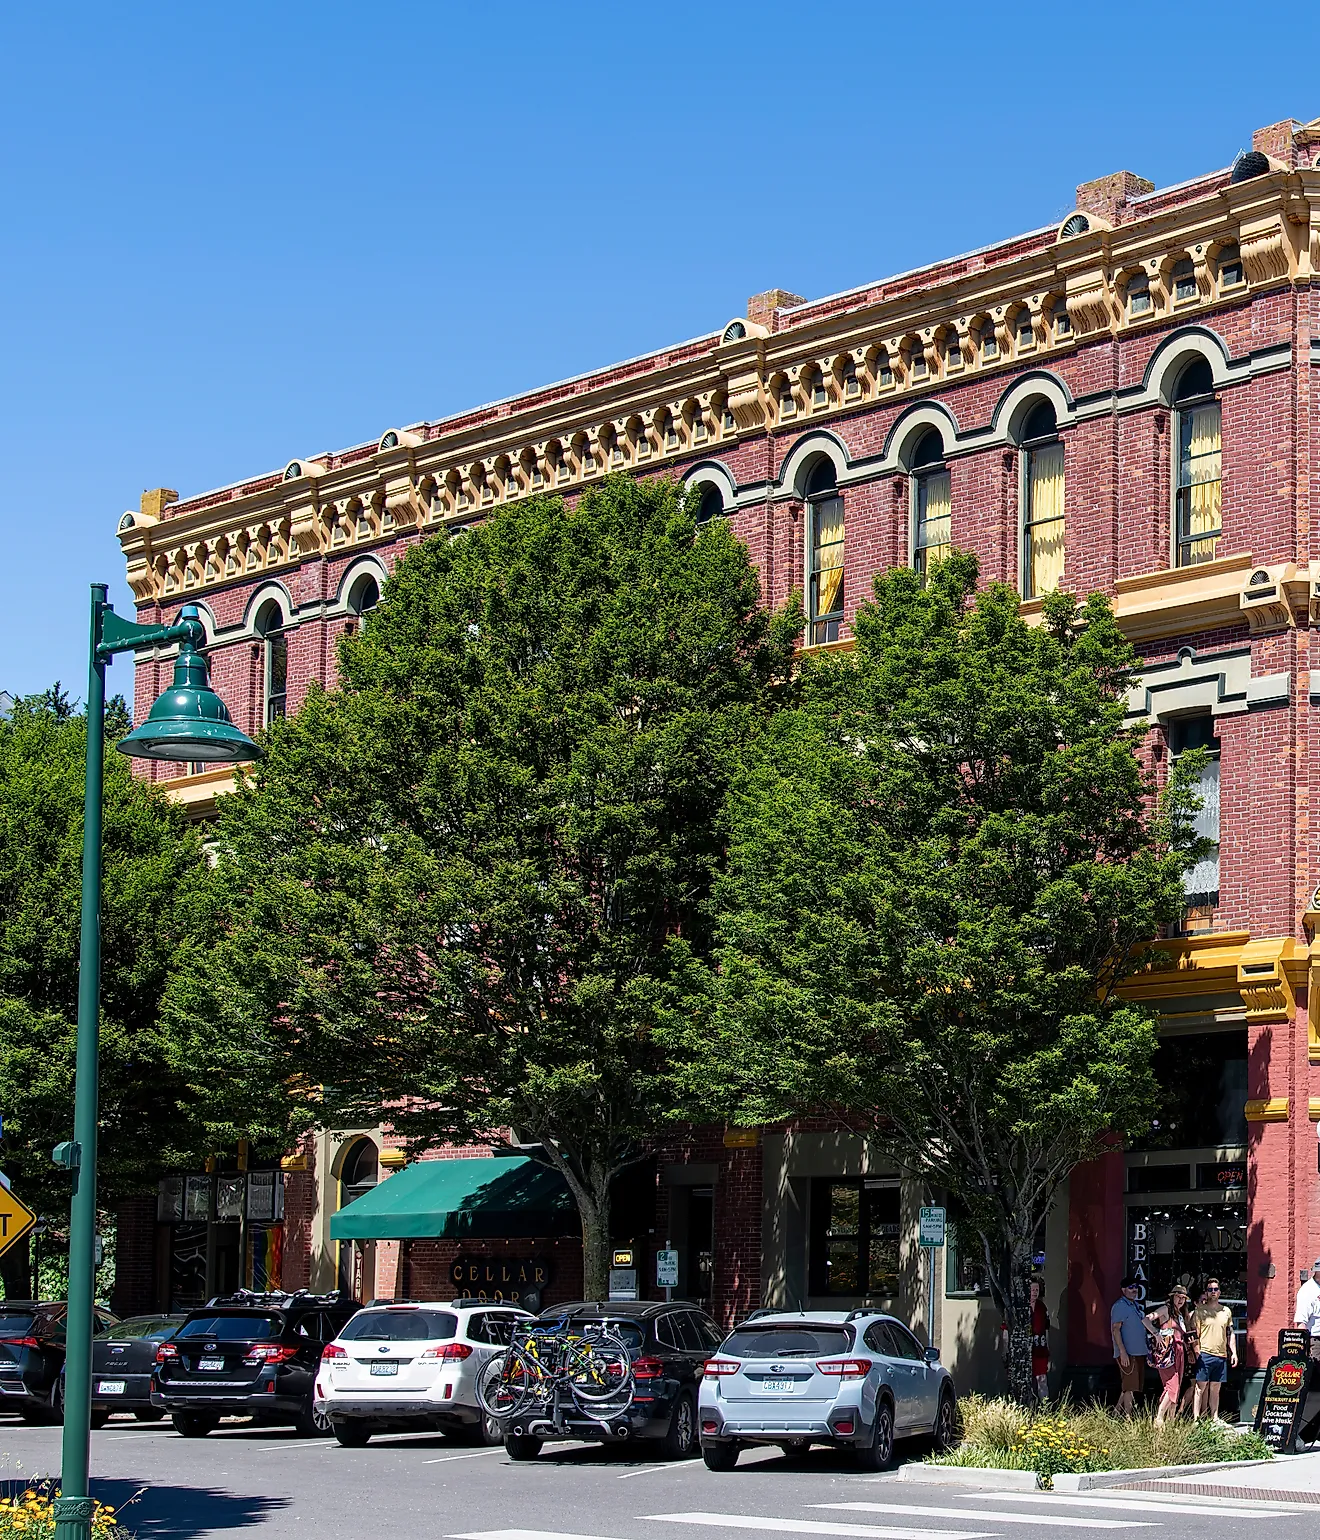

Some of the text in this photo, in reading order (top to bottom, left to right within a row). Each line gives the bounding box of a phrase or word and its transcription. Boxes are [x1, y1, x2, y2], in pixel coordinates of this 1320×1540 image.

[1217, 1171, 1243, 1183] OPEN
[616, 1254, 630, 1262] OPEN
[453, 1265, 545, 1283] CELLAR
[1275, 1370, 1301, 1378] CELLAR
[1277, 1377, 1297, 1385] DOOR
[1265, 1410, 1293, 1418] Cocktails
